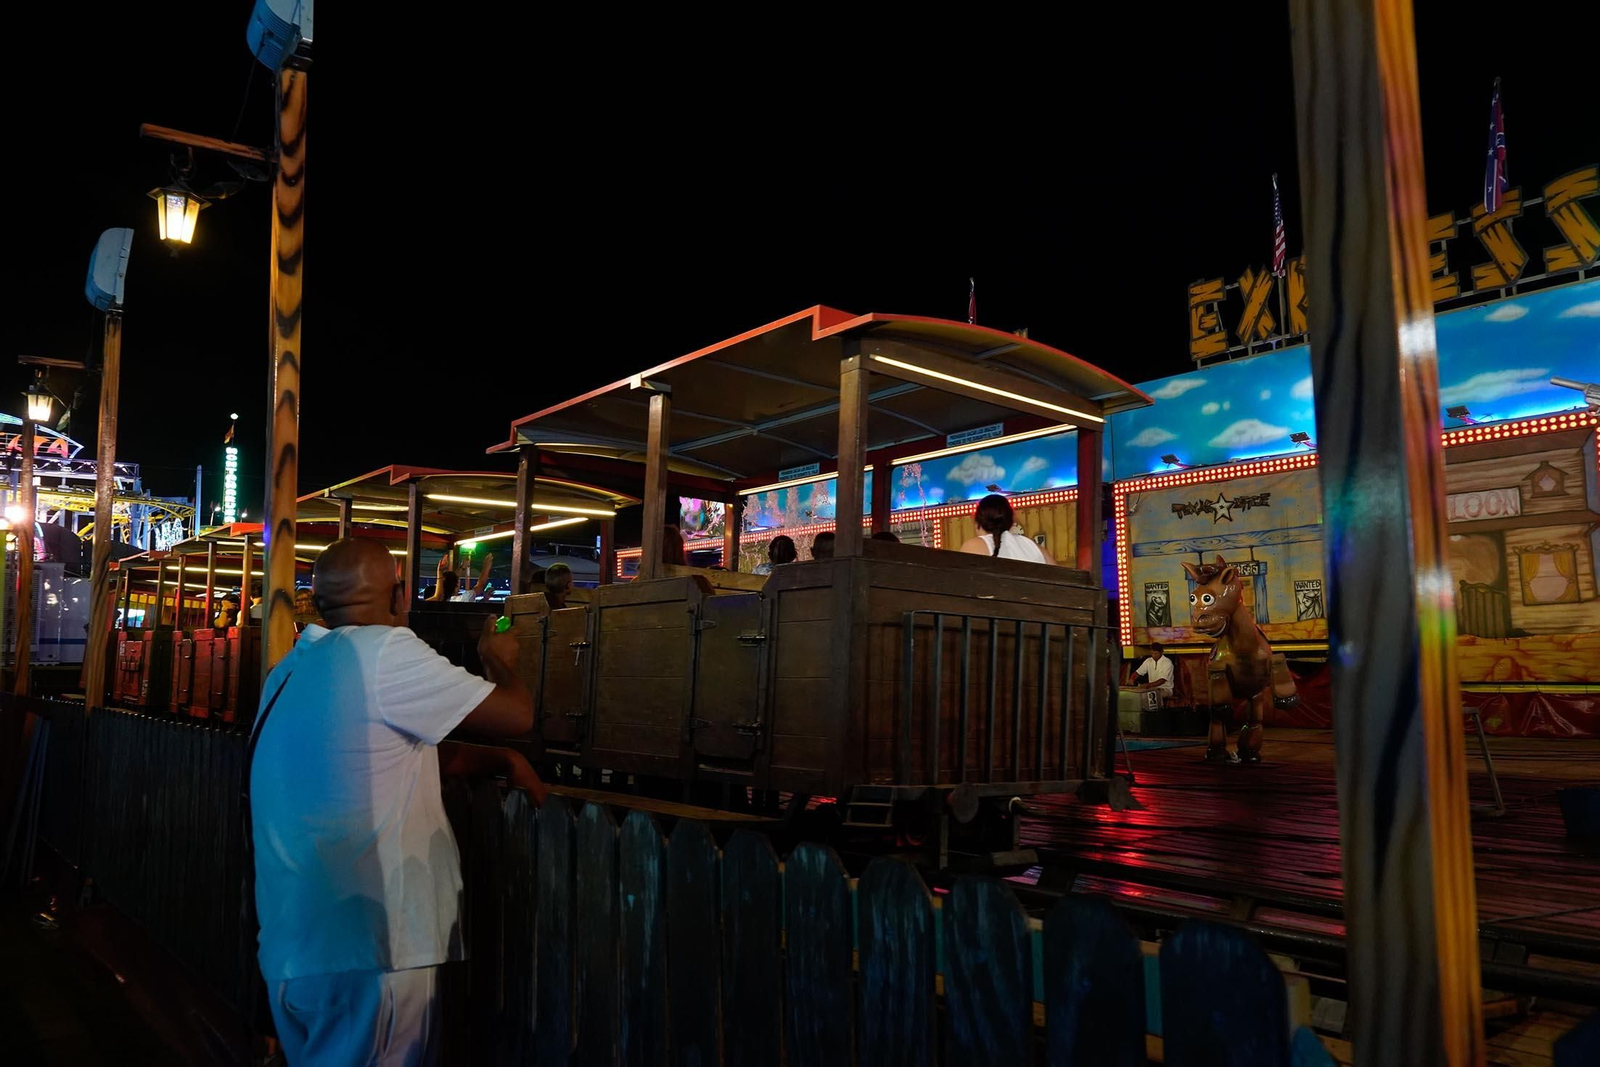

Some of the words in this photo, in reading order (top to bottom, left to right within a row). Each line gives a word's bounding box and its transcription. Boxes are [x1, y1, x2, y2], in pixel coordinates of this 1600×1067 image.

[1188, 162, 1600, 361] EXESS
[1447, 489, 1519, 521] LOON
[1145, 582, 1169, 590] WANTED
[1294, 580, 1321, 589] WANTED
